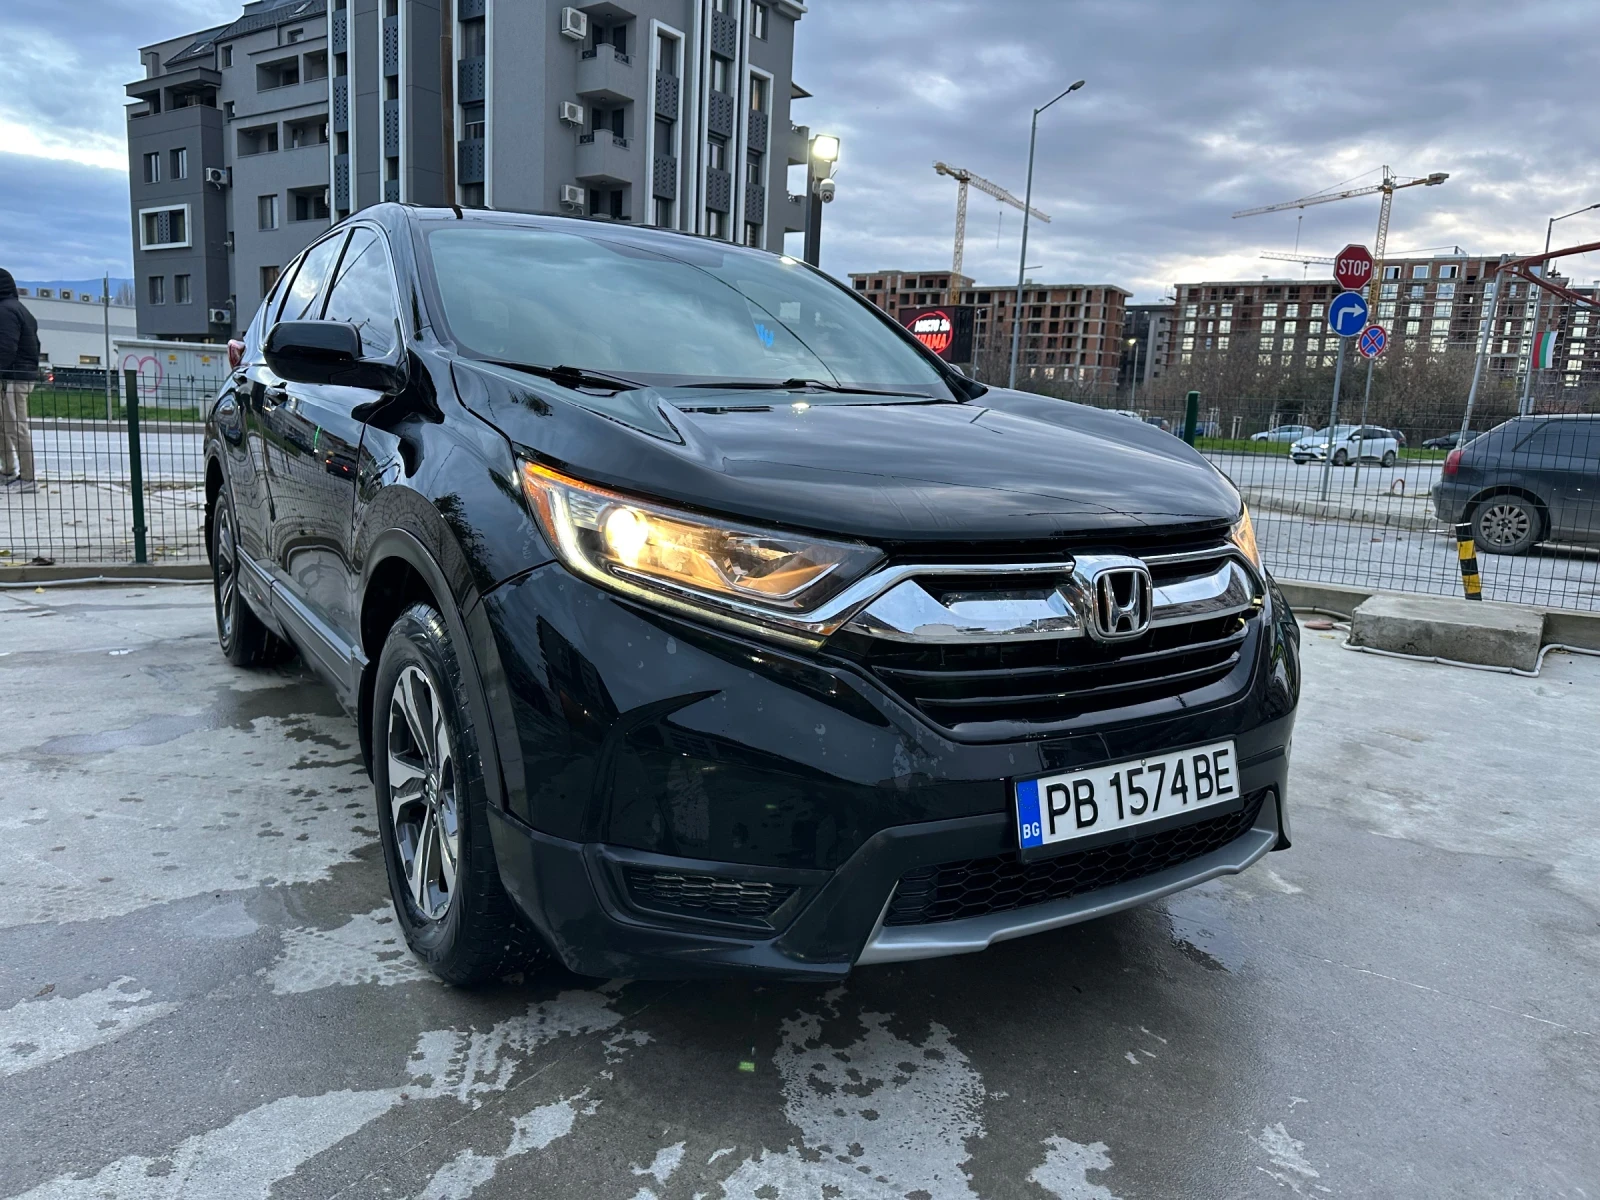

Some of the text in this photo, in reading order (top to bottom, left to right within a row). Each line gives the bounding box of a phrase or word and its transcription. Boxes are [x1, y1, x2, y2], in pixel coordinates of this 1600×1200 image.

[1339, 259, 1370, 276] STOP
[1046, 748, 1233, 834] PB 1574 BE
[1022, 822, 1040, 839] BG
